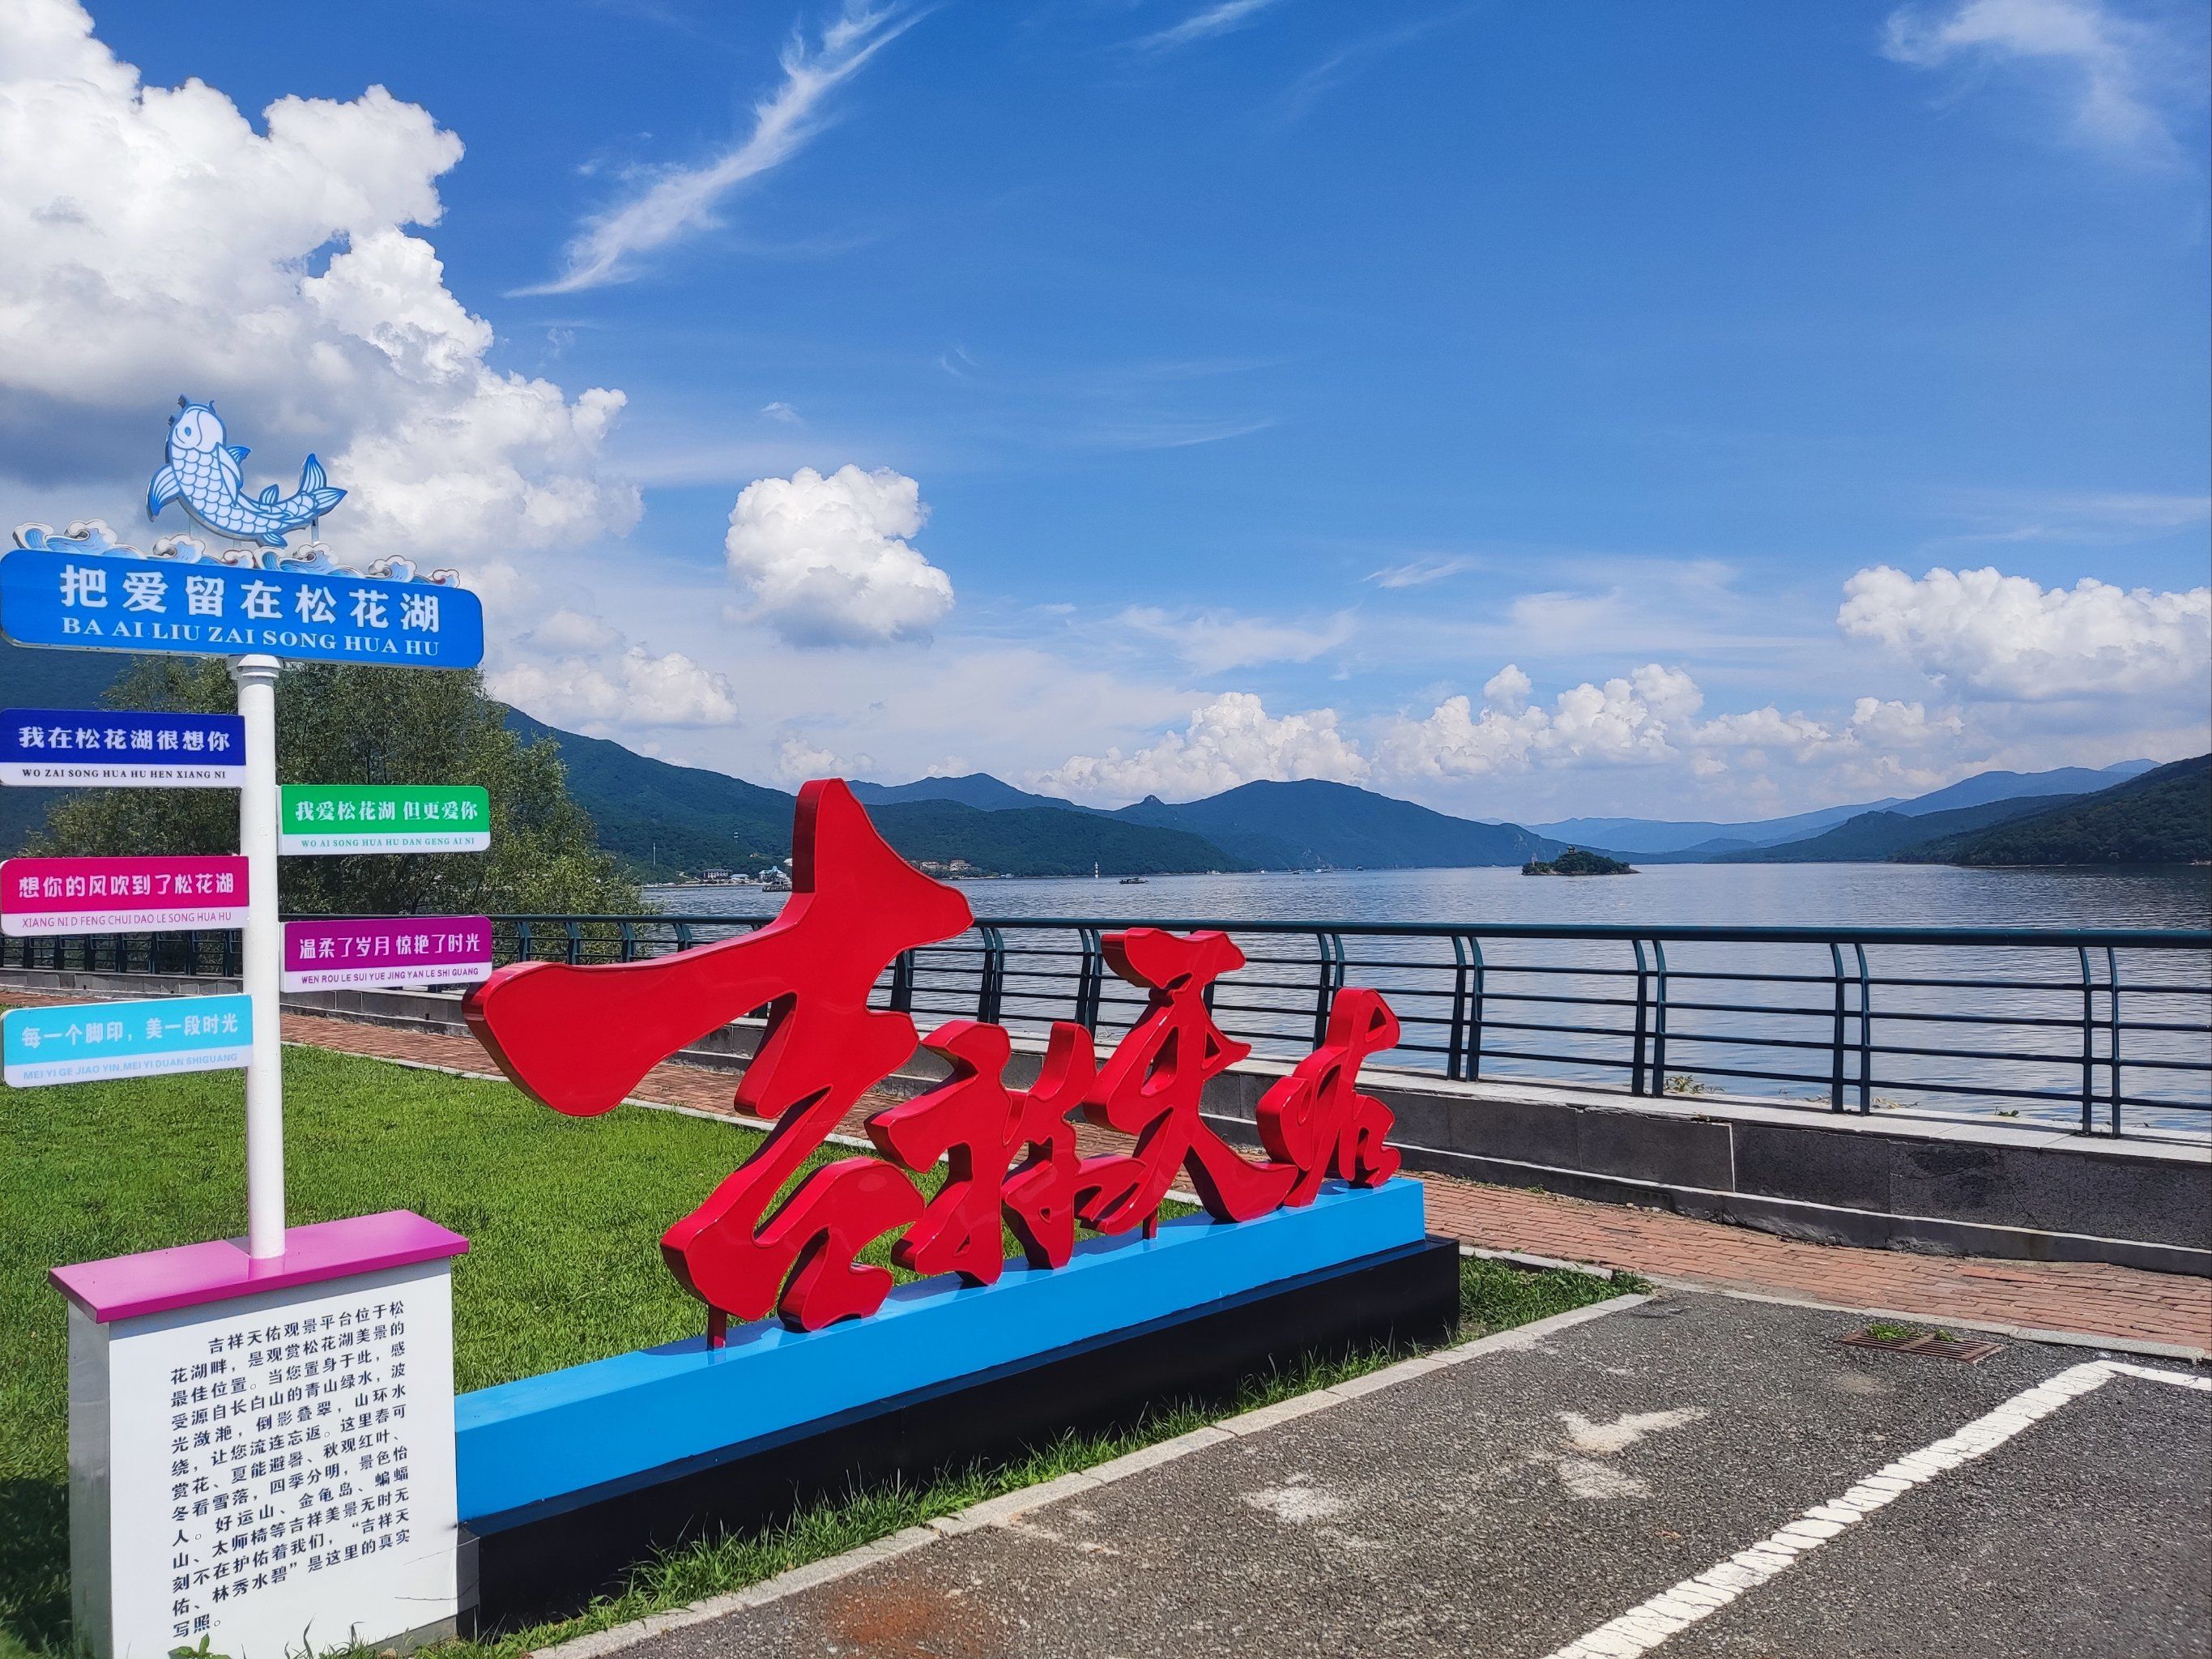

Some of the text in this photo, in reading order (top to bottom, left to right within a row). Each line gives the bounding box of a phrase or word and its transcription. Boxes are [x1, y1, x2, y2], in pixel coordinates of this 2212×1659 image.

[60, 564, 439, 633] 把爱留在松花湖
[62, 616, 439, 656] BA AI LIU ZAI SONG HUA HU
[19, 726, 230, 752] 我在松花湖很想你
[22, 769, 40, 777] WO
[45, 769, 64, 777] ZAI
[68, 770, 98, 778] SONG
[103, 770, 126, 778] HUA
[177, 770, 211, 778] XIANG
[296, 801, 478, 821] 我爱松花湖 但更爱你
[362, 838, 382, 847] HUA
[19, 872, 233, 898] 想你的风吹到了松花湖
[23, 911, 232, 928] XIANG NI D FENG CHUI DAO LE SONG HUA HU
[299, 932, 480, 960] 温柔了岁月 惊艳了时光
[302, 975, 319, 983] WEN
[322, 975, 339, 983] ROU
[342, 974, 352, 982] LE
[354, 973, 367, 981] SUI
[369, 972, 385, 980] YUE
[388, 971, 406, 979] JING
[407, 970, 424, 979] YAN
[437, 969, 450, 977] SHI
[23, 1070, 43, 1079] MEI
[46, 1069, 56, 1077] YI
[59, 1068, 73, 1077] GE
[76, 1065, 100, 1075] JIAO
[143, 1061, 152, 1069] YI
[156, 1059, 183, 1068] DUAN
[208, 1300, 404, 1354] 吉祥天佑观景平台位于松
[173, 1614, 220, 1638] 写照。
